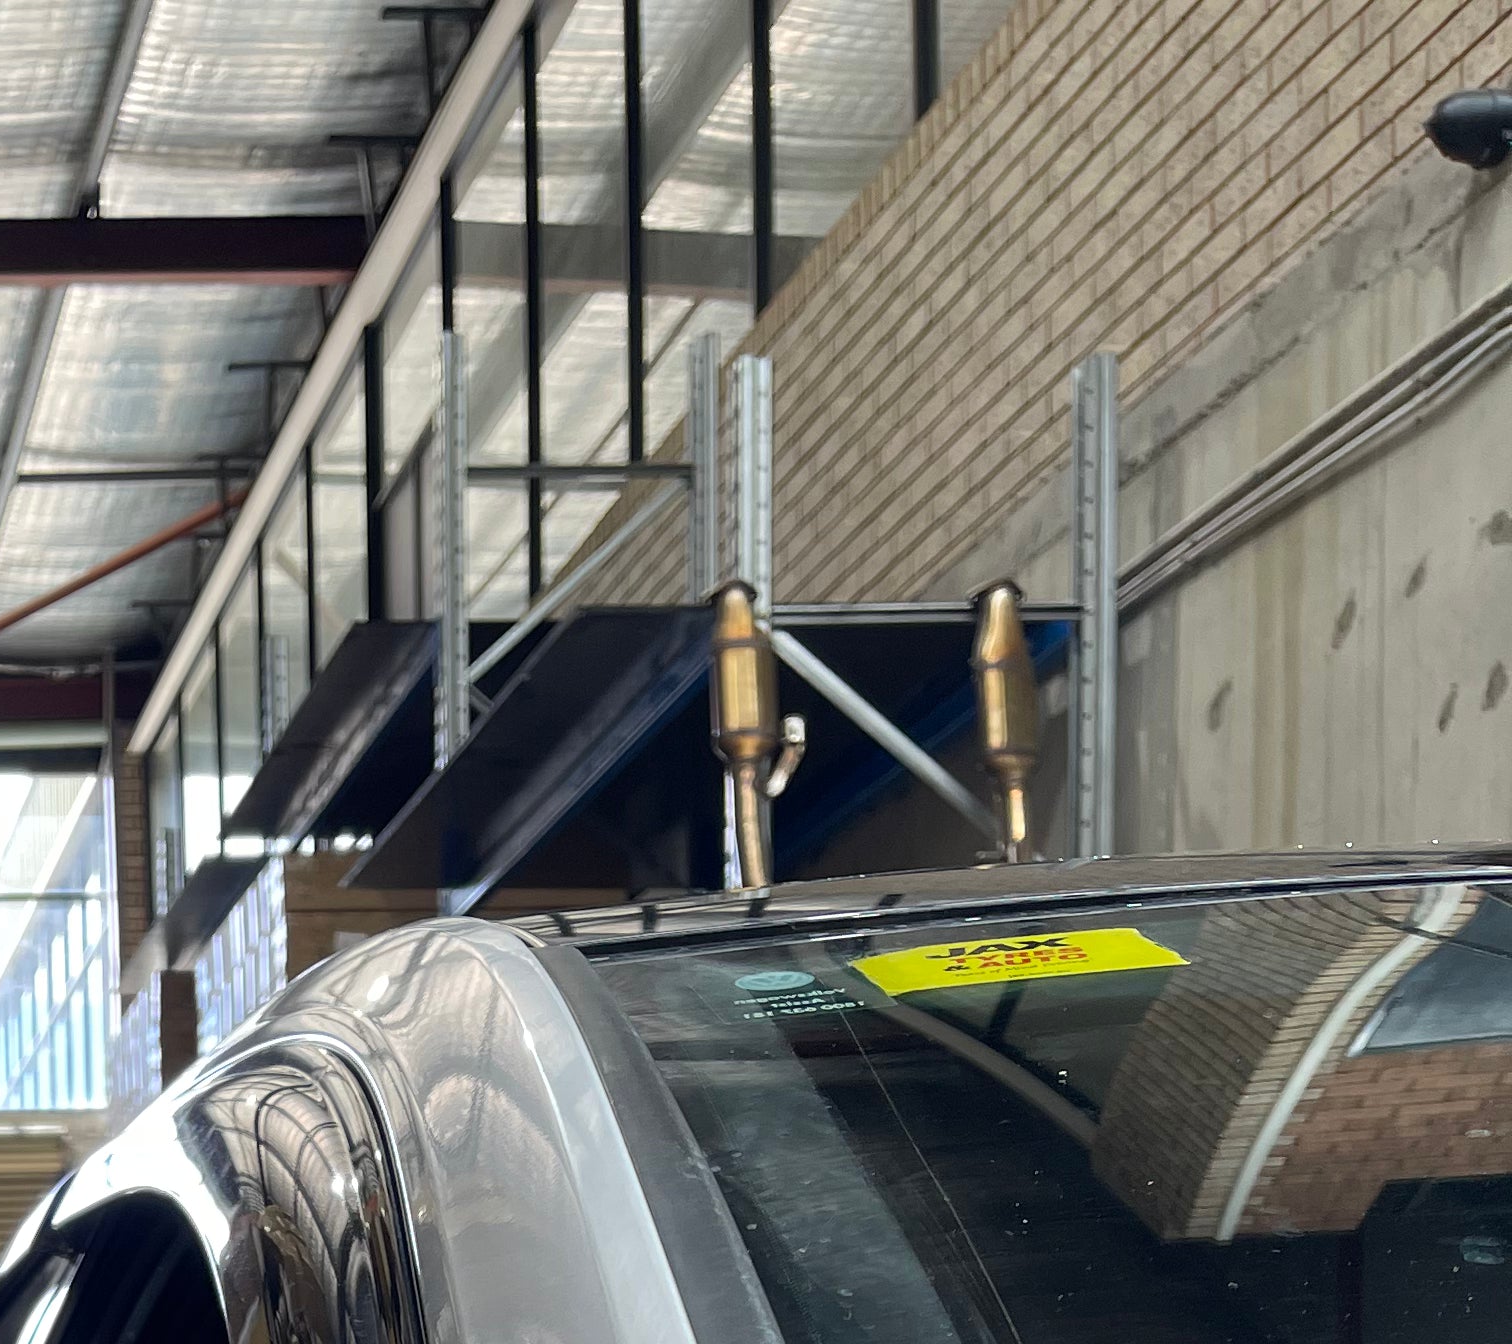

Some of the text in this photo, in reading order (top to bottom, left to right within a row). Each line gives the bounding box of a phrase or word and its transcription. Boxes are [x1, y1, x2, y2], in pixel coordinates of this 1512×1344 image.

[925, 937, 1070, 959] JAX
[950, 947, 1083, 964] TYRES
[979, 953, 1088, 968] AUTO
